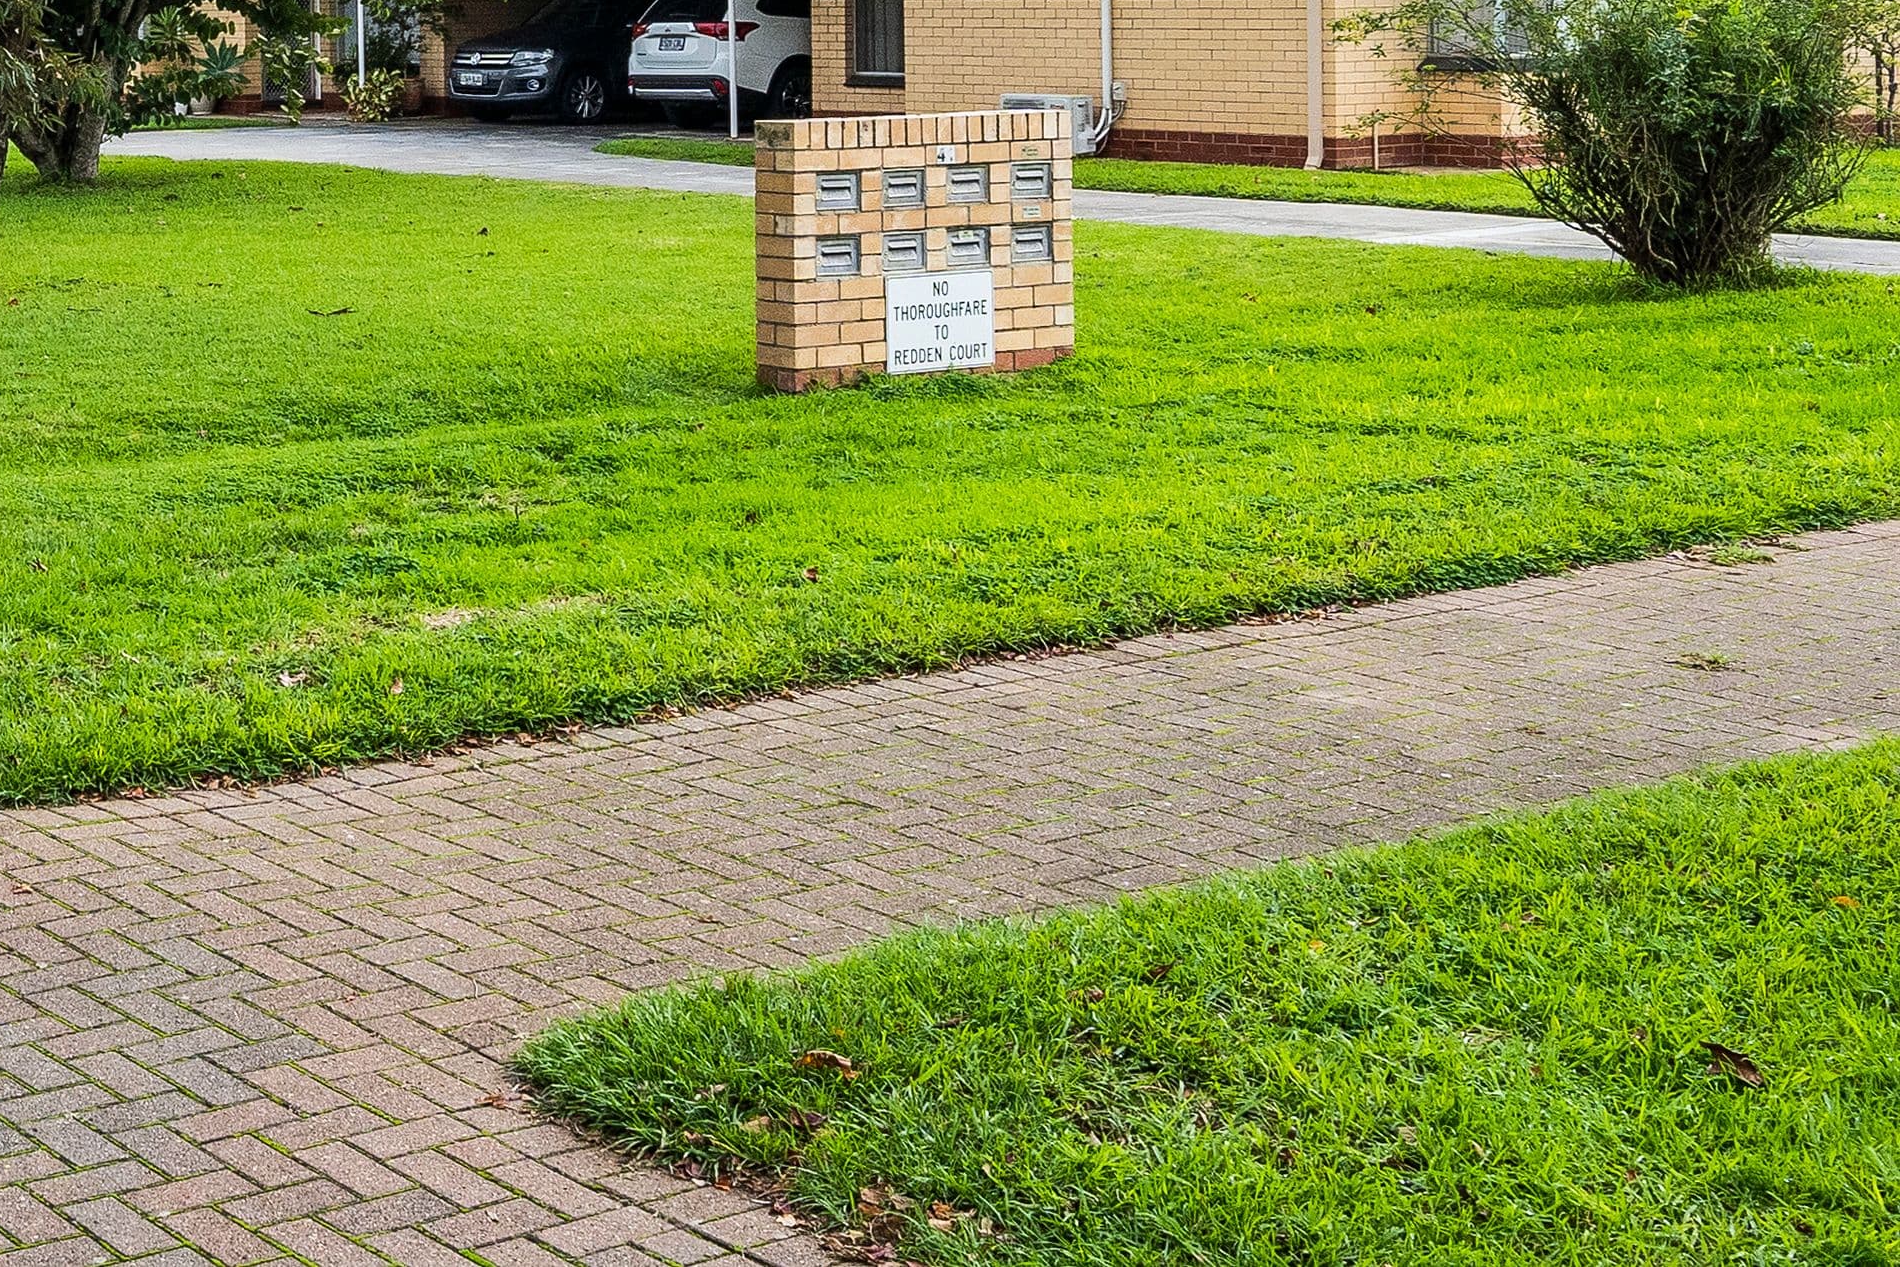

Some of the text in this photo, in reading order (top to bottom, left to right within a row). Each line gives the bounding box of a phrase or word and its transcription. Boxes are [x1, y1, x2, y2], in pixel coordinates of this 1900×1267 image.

[932, 280, 949, 296] NO
[893, 299, 988, 321] THOROUGHFARE
[934, 324, 949, 340] TO
[894, 342, 988, 366] REDDEN COURT
